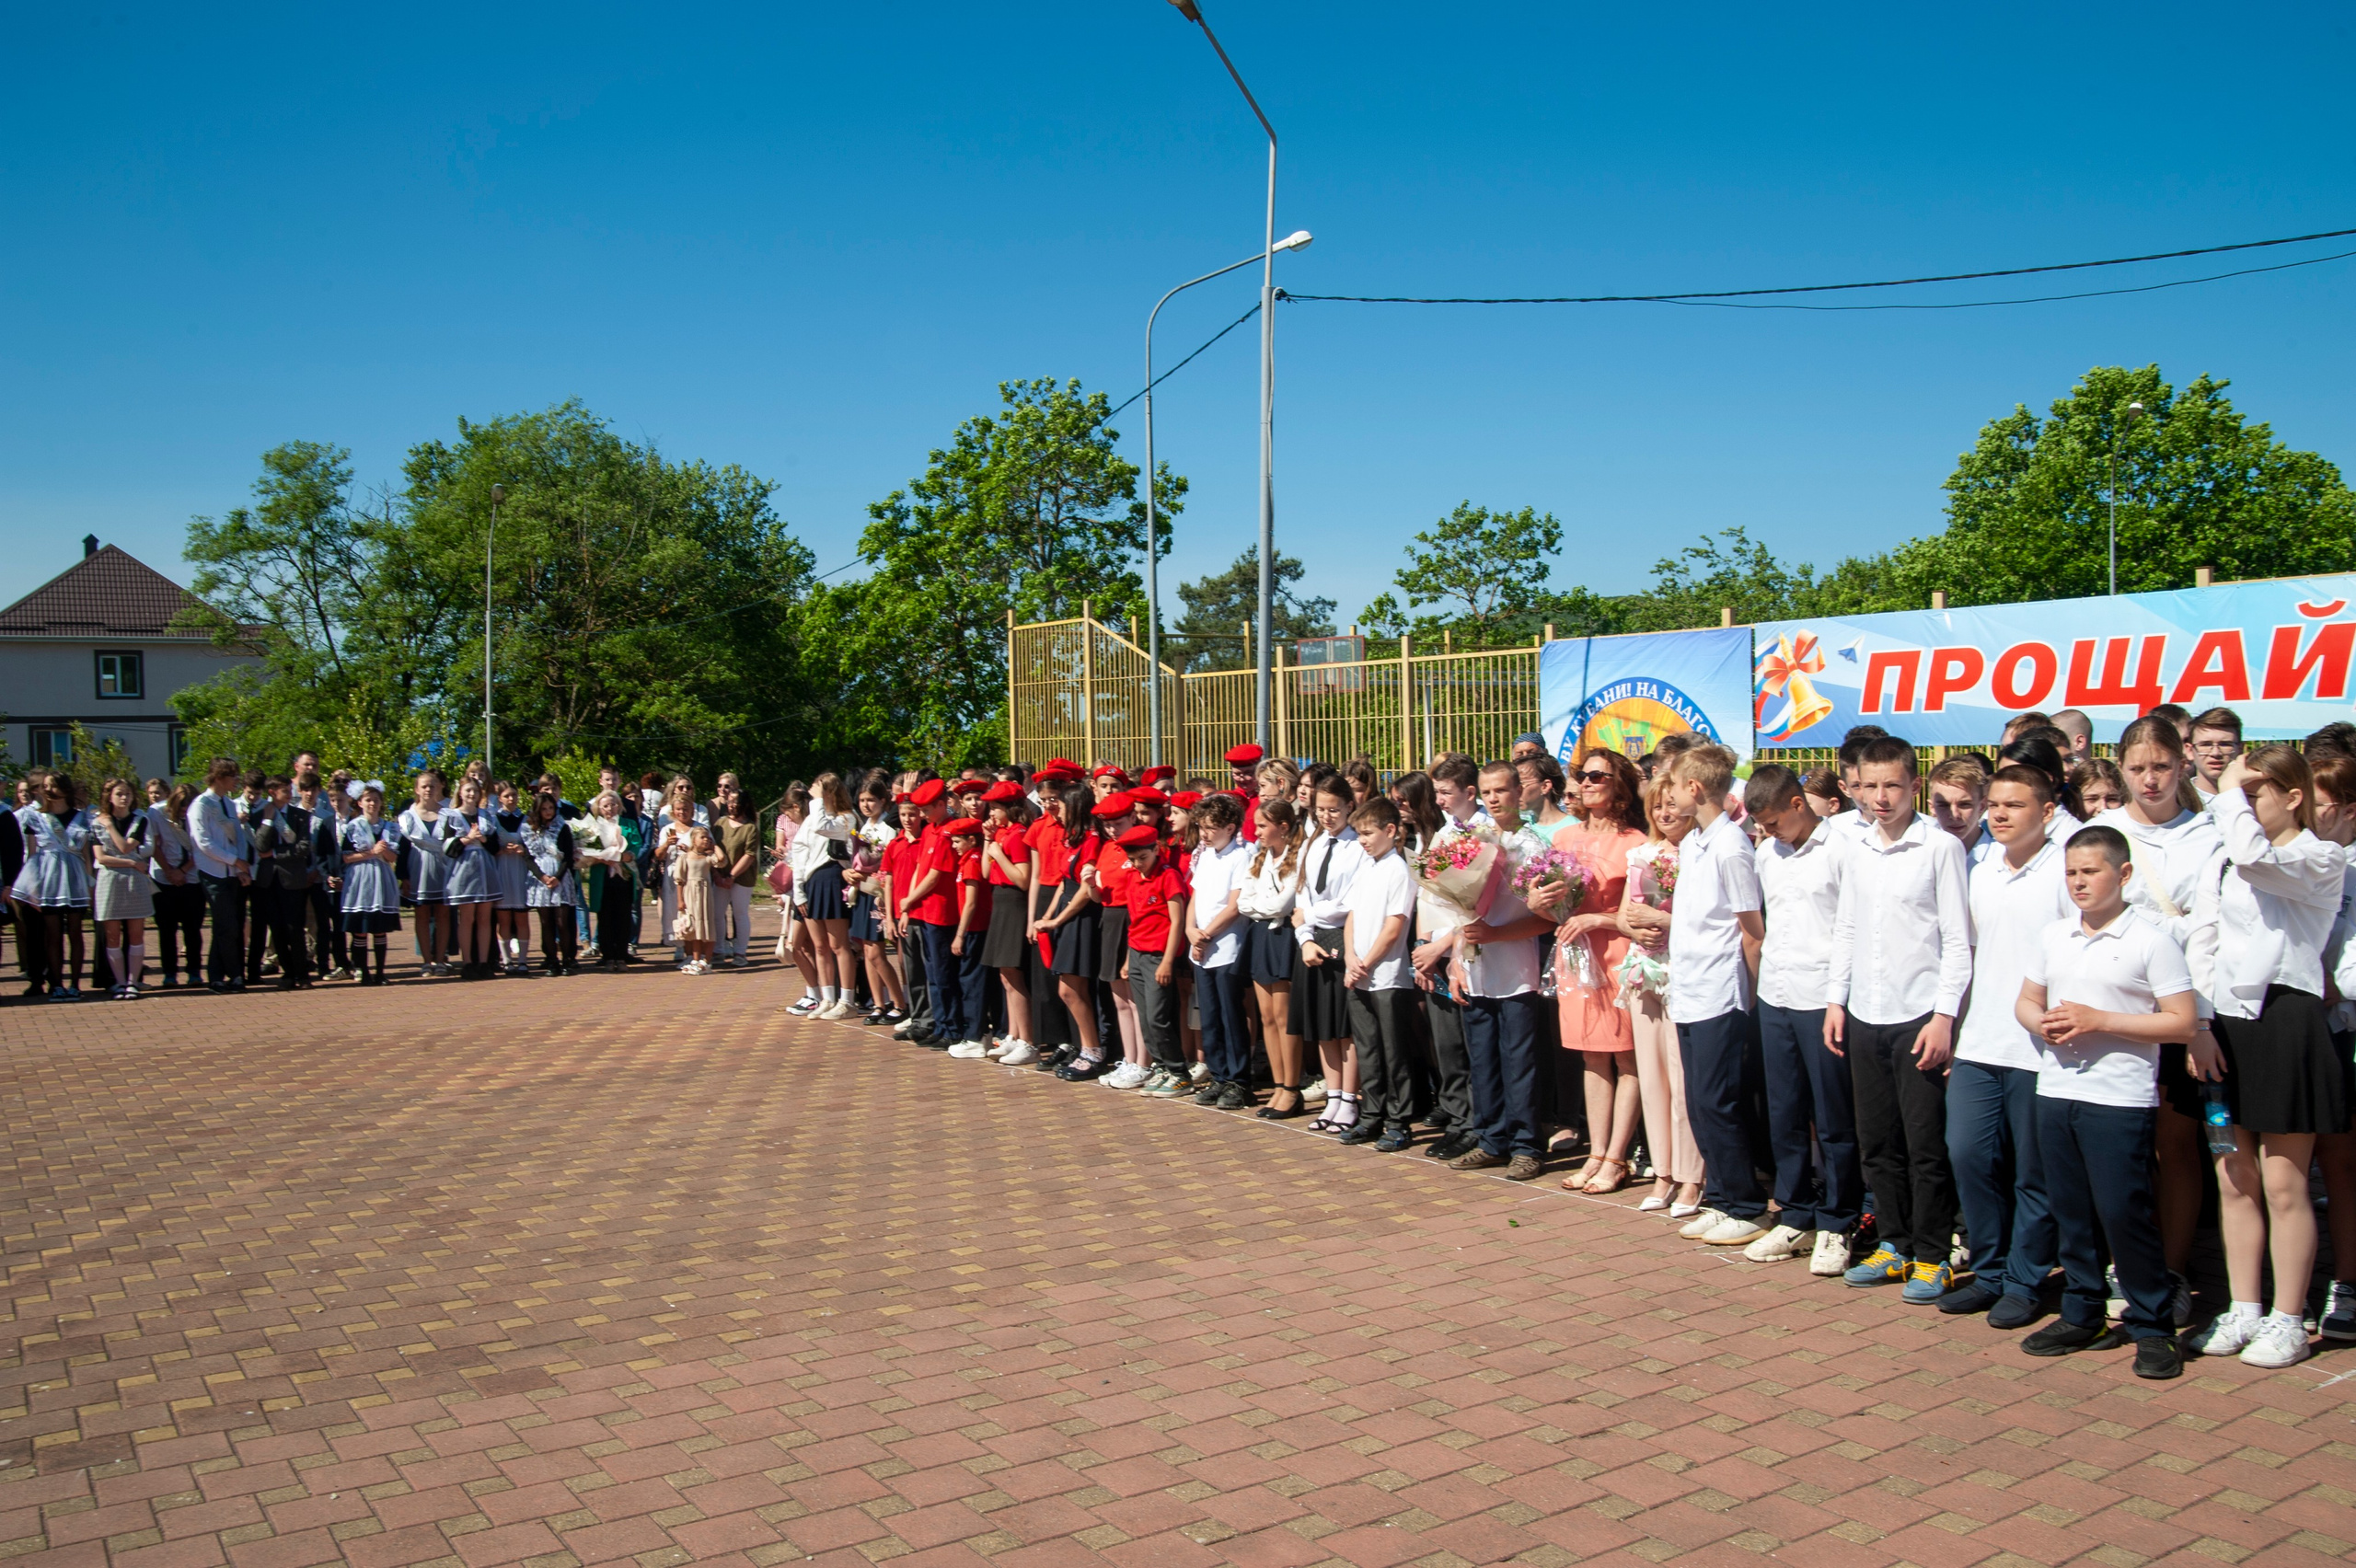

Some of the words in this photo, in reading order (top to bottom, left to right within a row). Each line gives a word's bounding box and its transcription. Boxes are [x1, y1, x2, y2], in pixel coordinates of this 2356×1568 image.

[1859, 599, 2356, 720] ПРОЩАЙ
[1559, 735, 1574, 763] ВУ
[1569, 683, 1632, 737] КУБАНИ!
[1635, 681, 1659, 700] НА
[1661, 688, 1711, 737] БЛАГО
